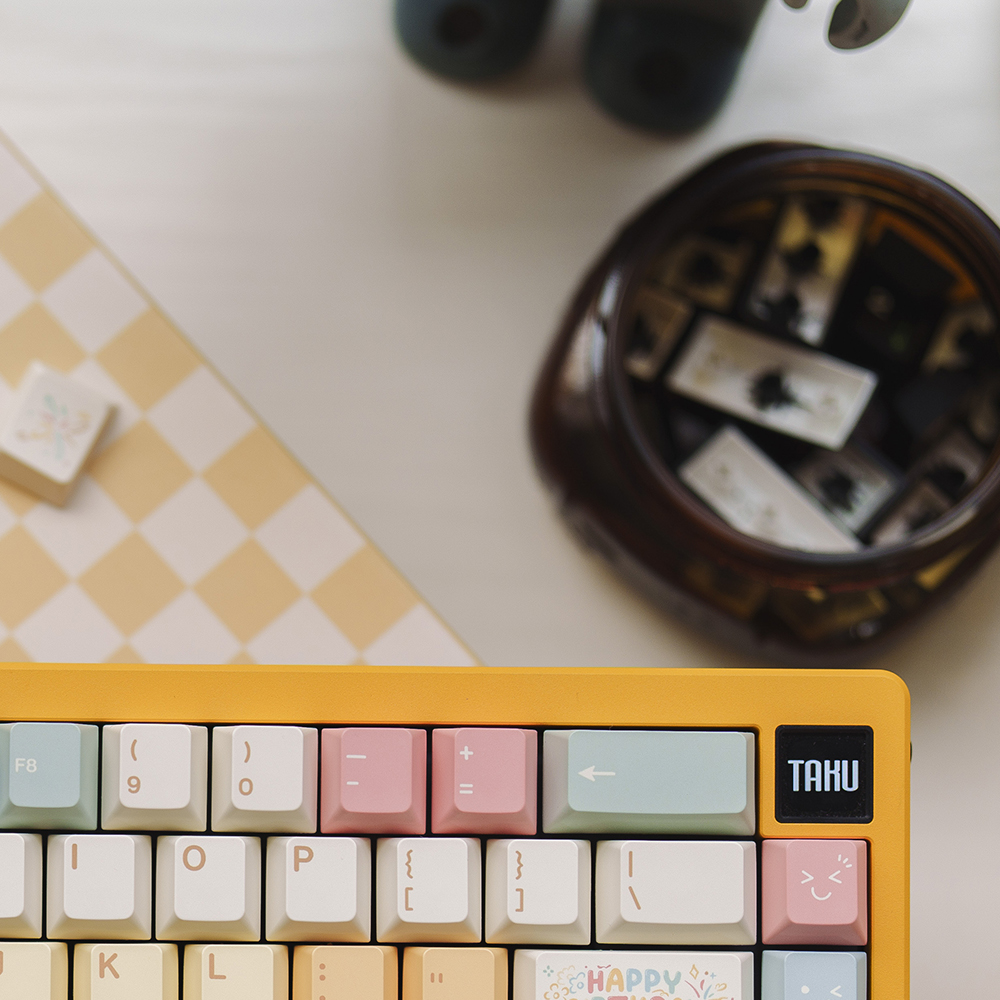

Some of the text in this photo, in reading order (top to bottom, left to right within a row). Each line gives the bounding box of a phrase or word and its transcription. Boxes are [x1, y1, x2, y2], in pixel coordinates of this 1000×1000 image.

[130, 738, 138, 762] (
[243, 740, 251, 764] )
[459, 745, 474, 761] +
[15, 757, 38, 773] F8
[787, 759, 859, 792] TAKU
[126, 775, 141, 794] 9
[459, 783, 474, 795] =
[71, 843, 78, 870] I
[182, 844, 207, 872] O
[293, 845, 314, 873] P
[404, 849, 414, 880] {
[515, 850, 524, 881] }
[404, 886, 414, 912] [
[514, 887, 524, 913] ]
[98, 951, 120, 980] K
[208, 952, 227, 980] L
[587, 967, 682, 995] HAPPY
